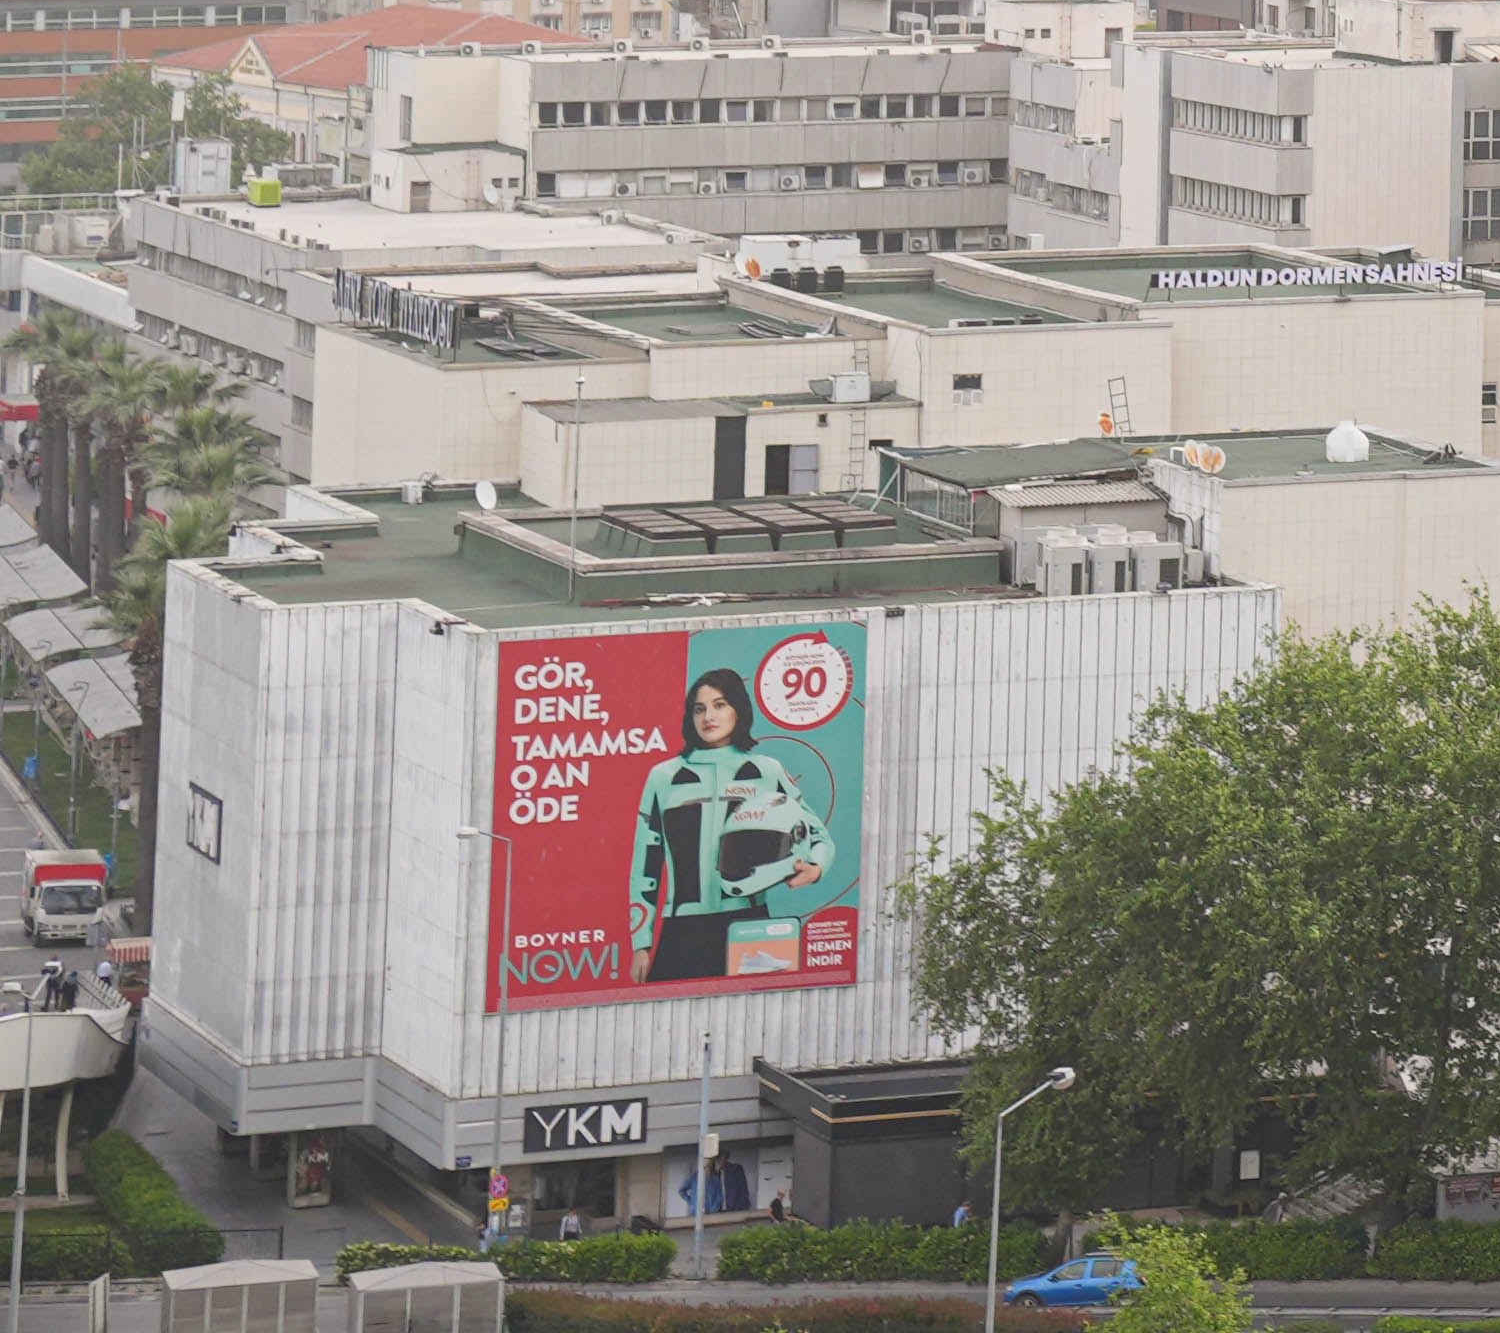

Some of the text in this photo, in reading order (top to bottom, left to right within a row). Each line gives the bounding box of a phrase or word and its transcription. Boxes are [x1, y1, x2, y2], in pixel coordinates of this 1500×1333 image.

[1157, 257, 1463, 289] HALDUN DORMEN SAHNESİ
[514, 656, 594, 693] GÖR,
[782, 666, 827, 700] 90
[514, 694, 610, 725] DENE,
[511, 727, 668, 761] TAMAMSA
[510, 761, 590, 791] O AN
[509, 791, 579, 825] ÖDE
[515, 929, 605, 949] BOYNER
[807, 940, 852, 953] HEMEN
[501, 942, 619, 986] NOW!
[807, 952, 842, 967] İNDİR
[532, 1102, 643, 1149] YKM
